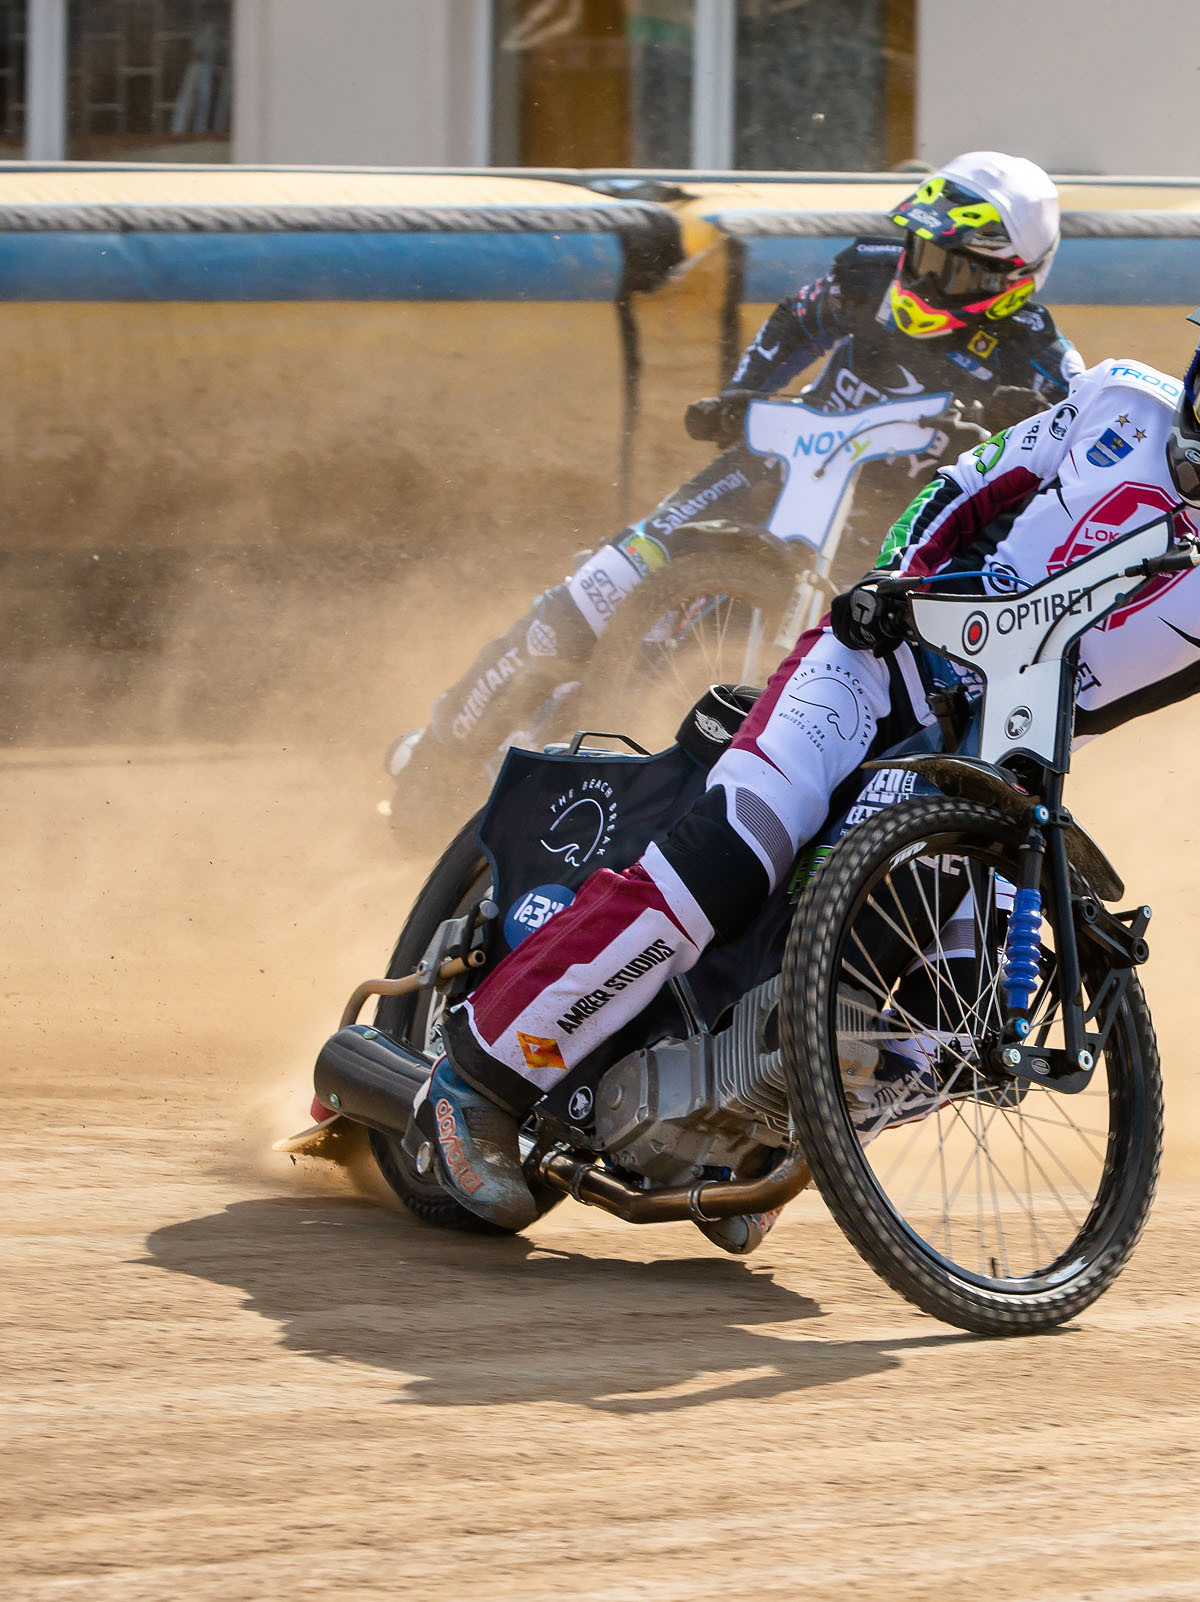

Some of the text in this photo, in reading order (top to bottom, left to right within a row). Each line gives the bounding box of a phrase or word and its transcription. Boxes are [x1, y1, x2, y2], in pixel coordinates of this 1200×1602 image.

[936, 587, 1093, 634] OPTIBET
[452, 647, 524, 739] CHEMART
[550, 788, 575, 813] THE
[582, 778, 613, 798] BEACH
[556, 938, 676, 1034] AMBER STUDIOS
[435, 1097, 485, 1195] daytona
